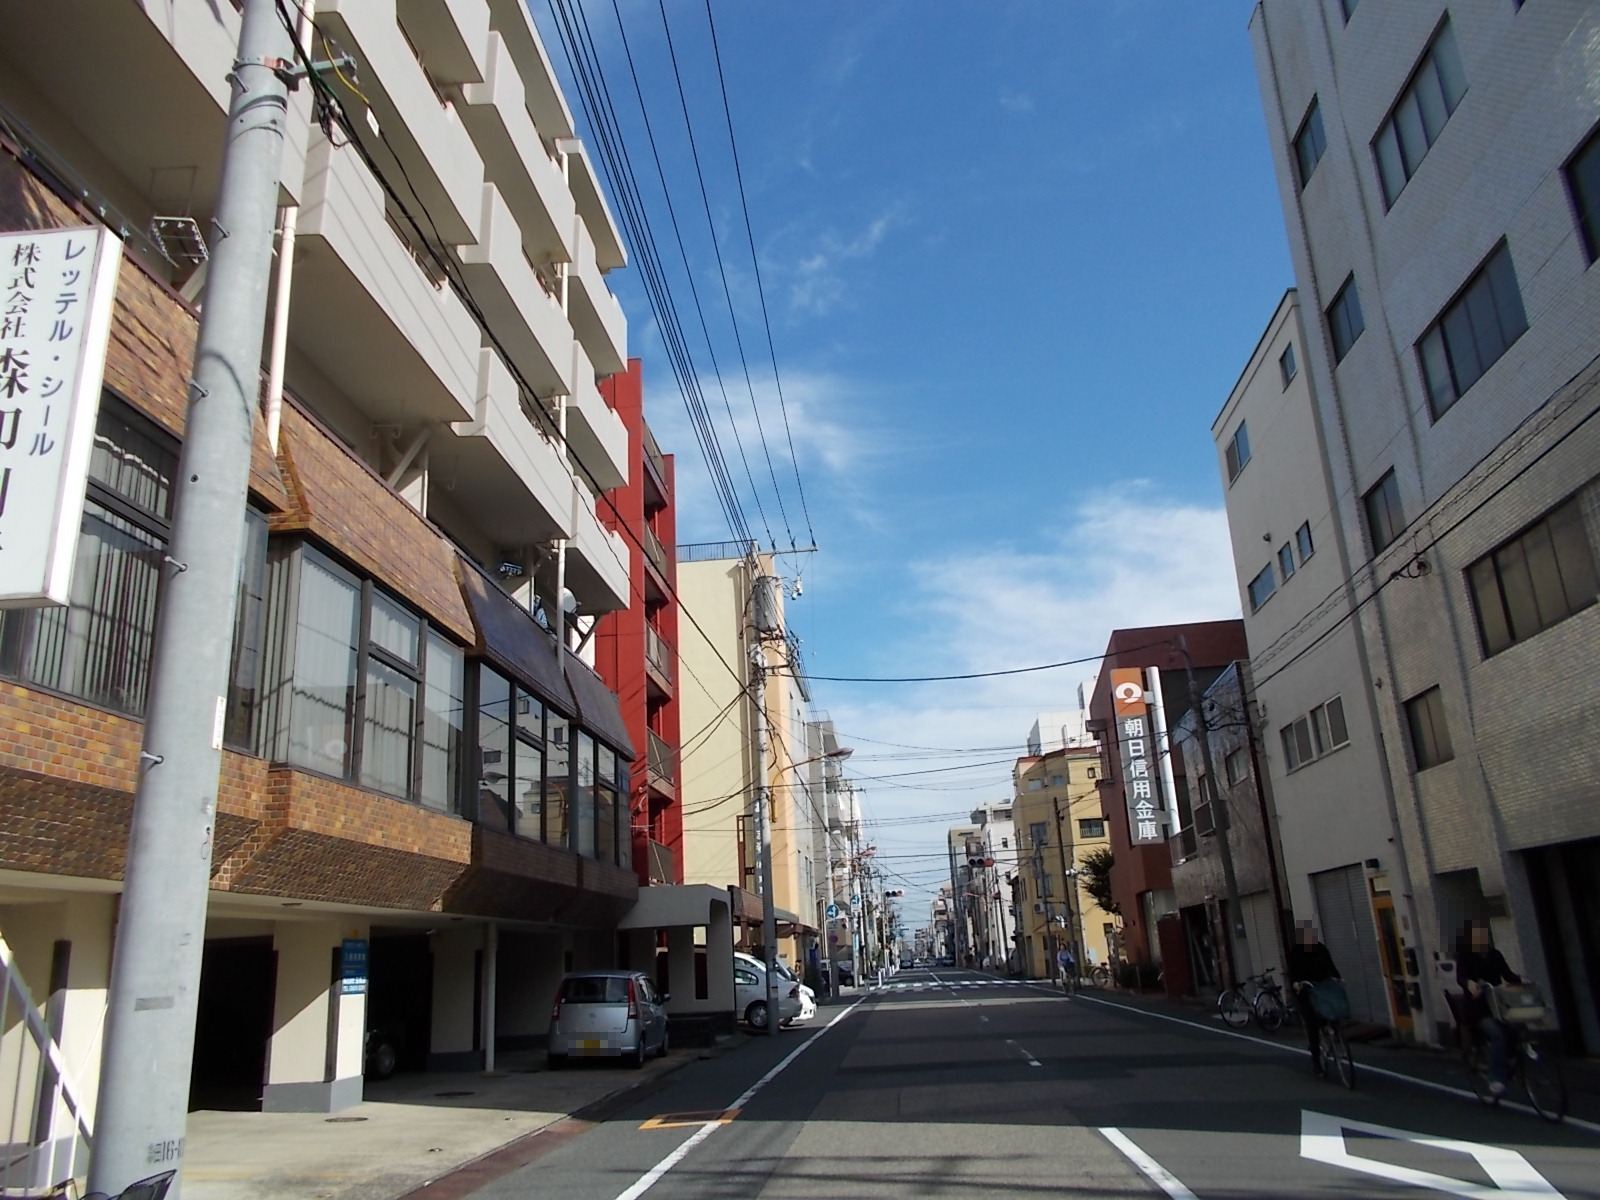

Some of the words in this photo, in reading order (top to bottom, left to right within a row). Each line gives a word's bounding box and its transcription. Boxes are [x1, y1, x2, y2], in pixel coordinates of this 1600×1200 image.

[29, 239, 86, 456] レッテル・シール
[1124, 718, 1159, 841] 朝日信用金庫
